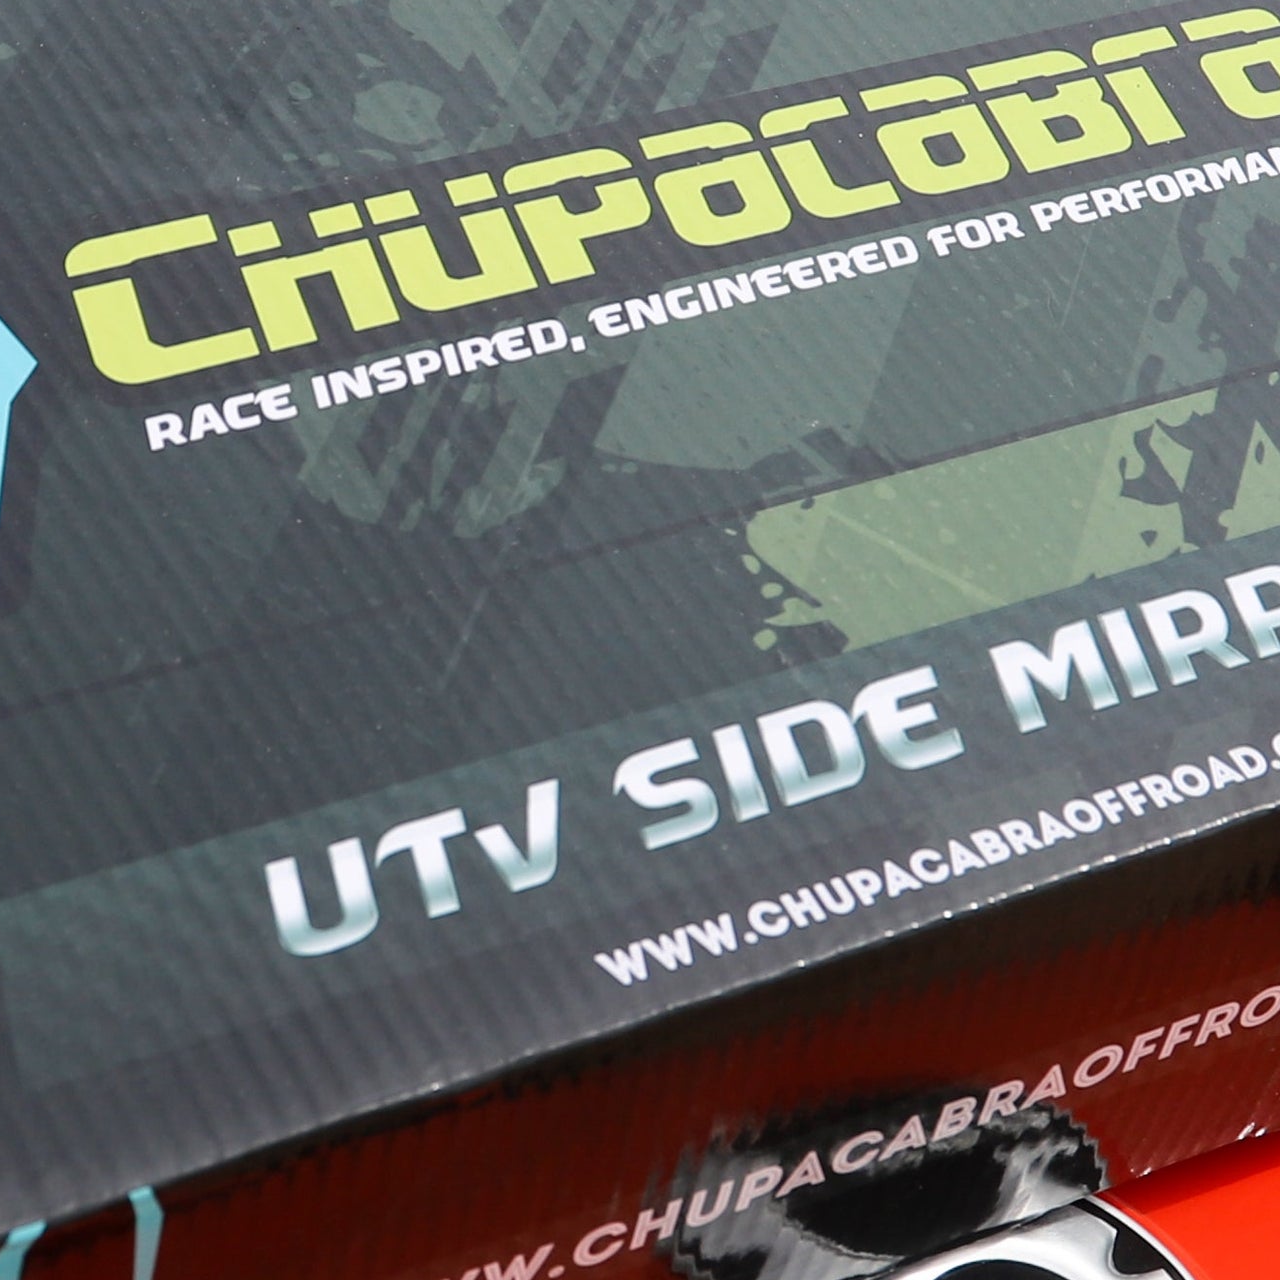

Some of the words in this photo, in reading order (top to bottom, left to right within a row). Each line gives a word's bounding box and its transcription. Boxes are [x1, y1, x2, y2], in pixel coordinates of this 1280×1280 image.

[144, 382, 299, 452] RACE
[310, 318, 588, 410] INSPIRED,
[587, 235, 920, 340] ENGINEERED
[925, 208, 1026, 258] FOR
[263, 775, 561, 958] UTV
[611, 663, 966, 852] SIDE
